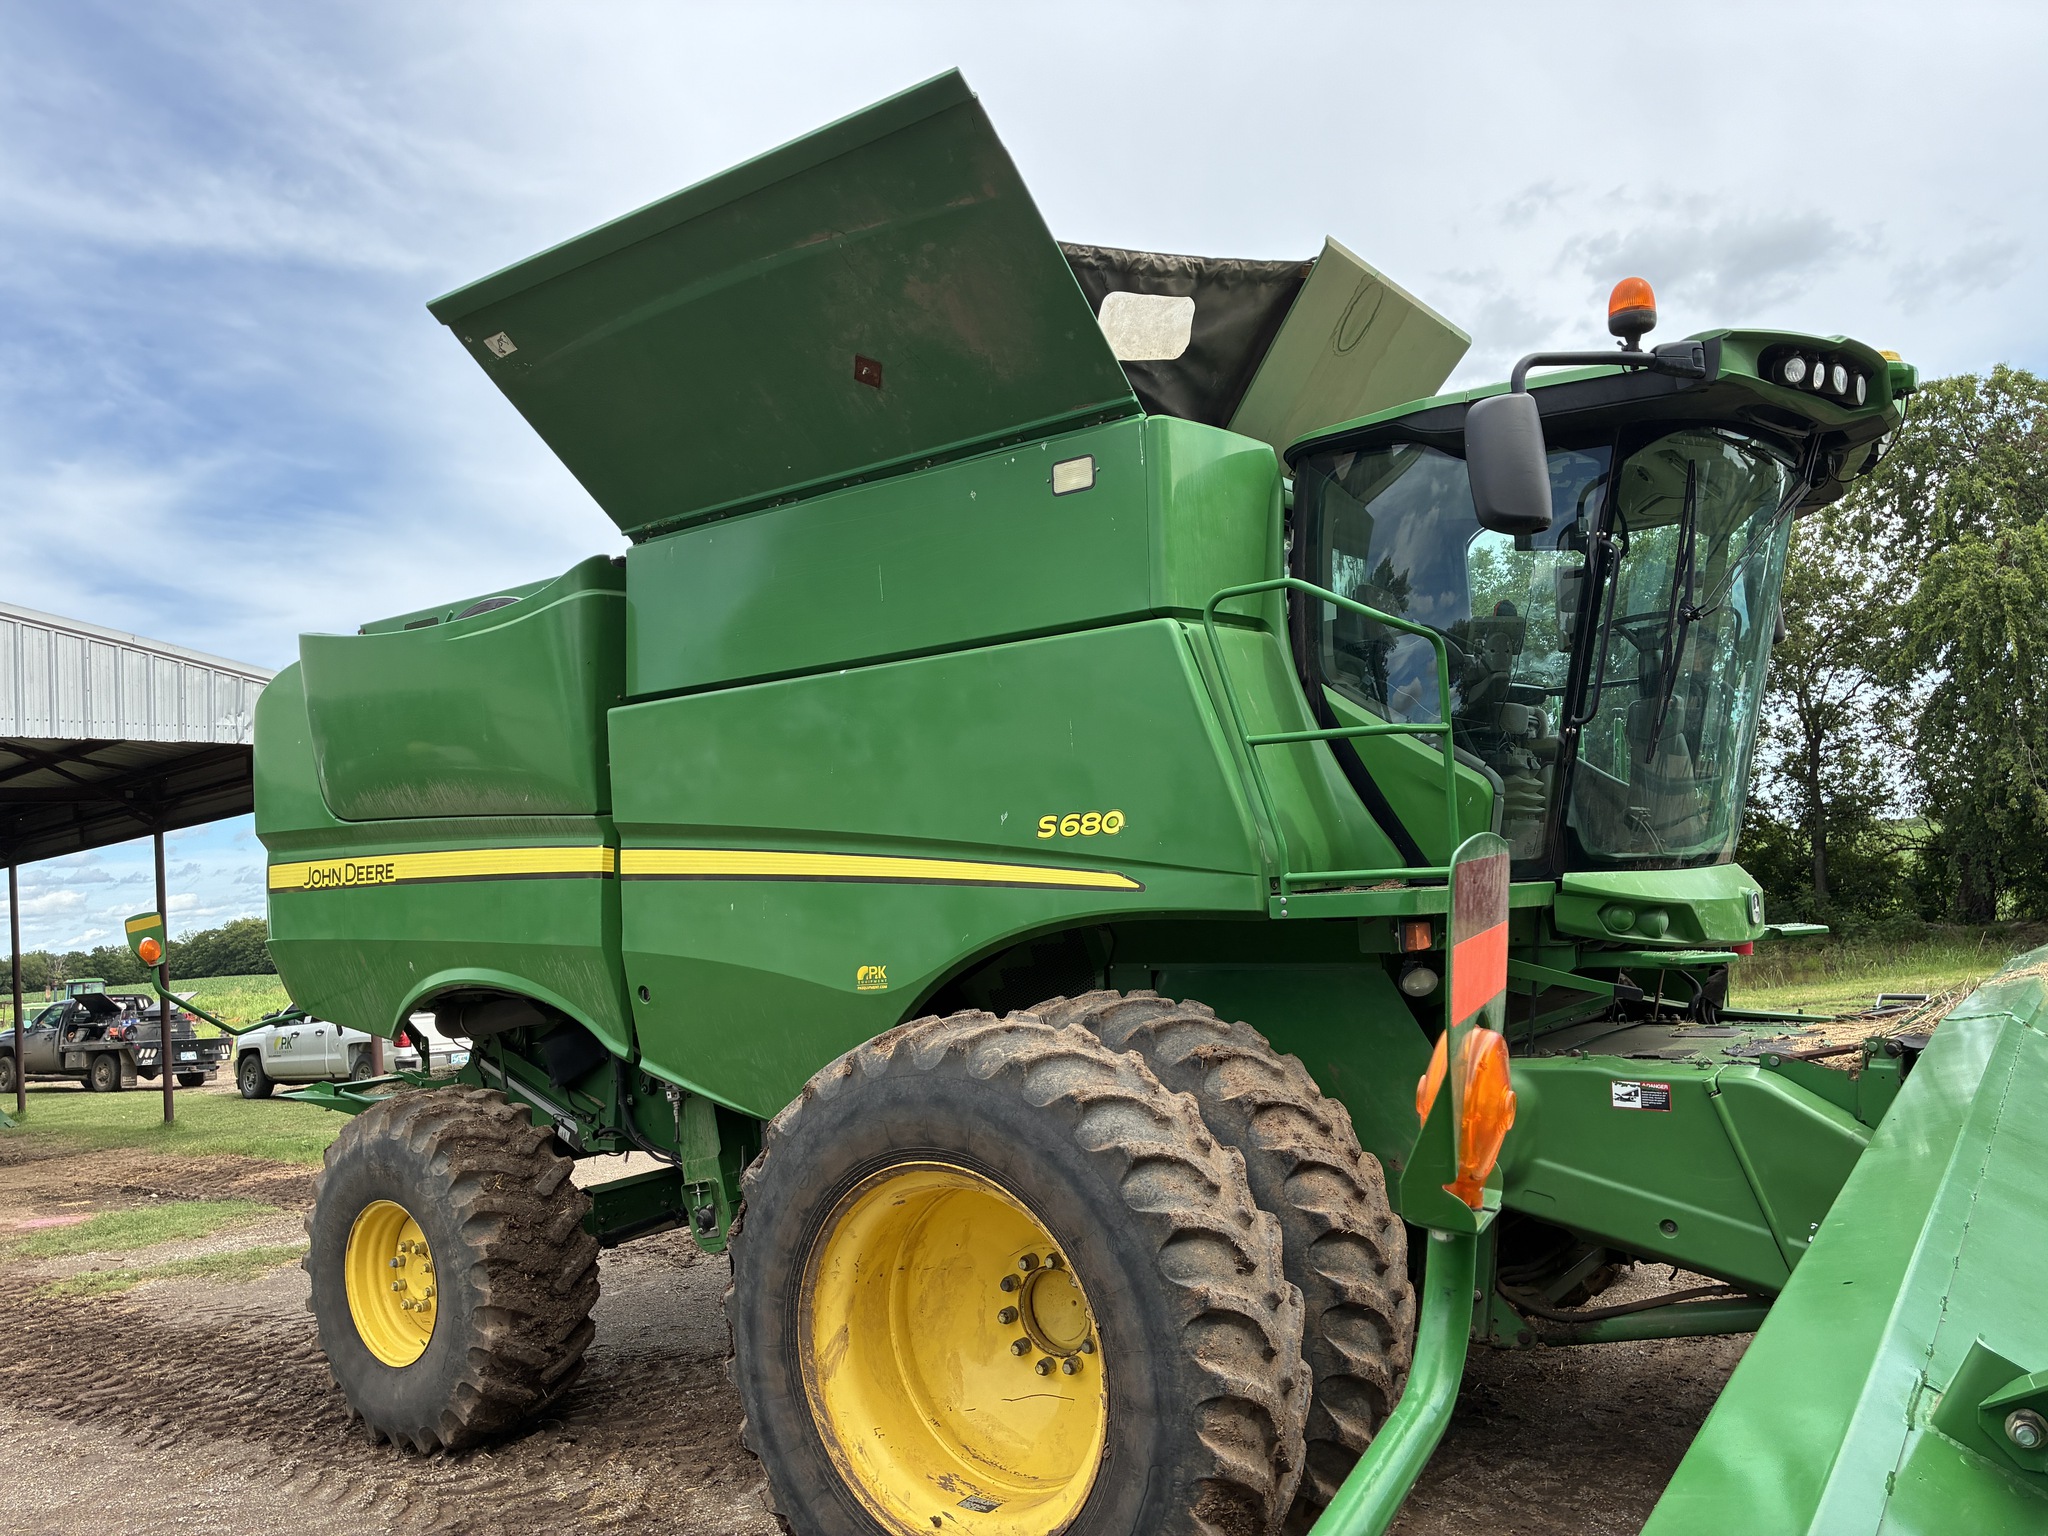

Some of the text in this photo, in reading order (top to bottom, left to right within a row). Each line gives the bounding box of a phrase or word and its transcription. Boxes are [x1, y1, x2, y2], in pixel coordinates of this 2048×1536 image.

[1037, 809, 1125, 839] S680
[303, 863, 395, 886] JOHN DEERE
